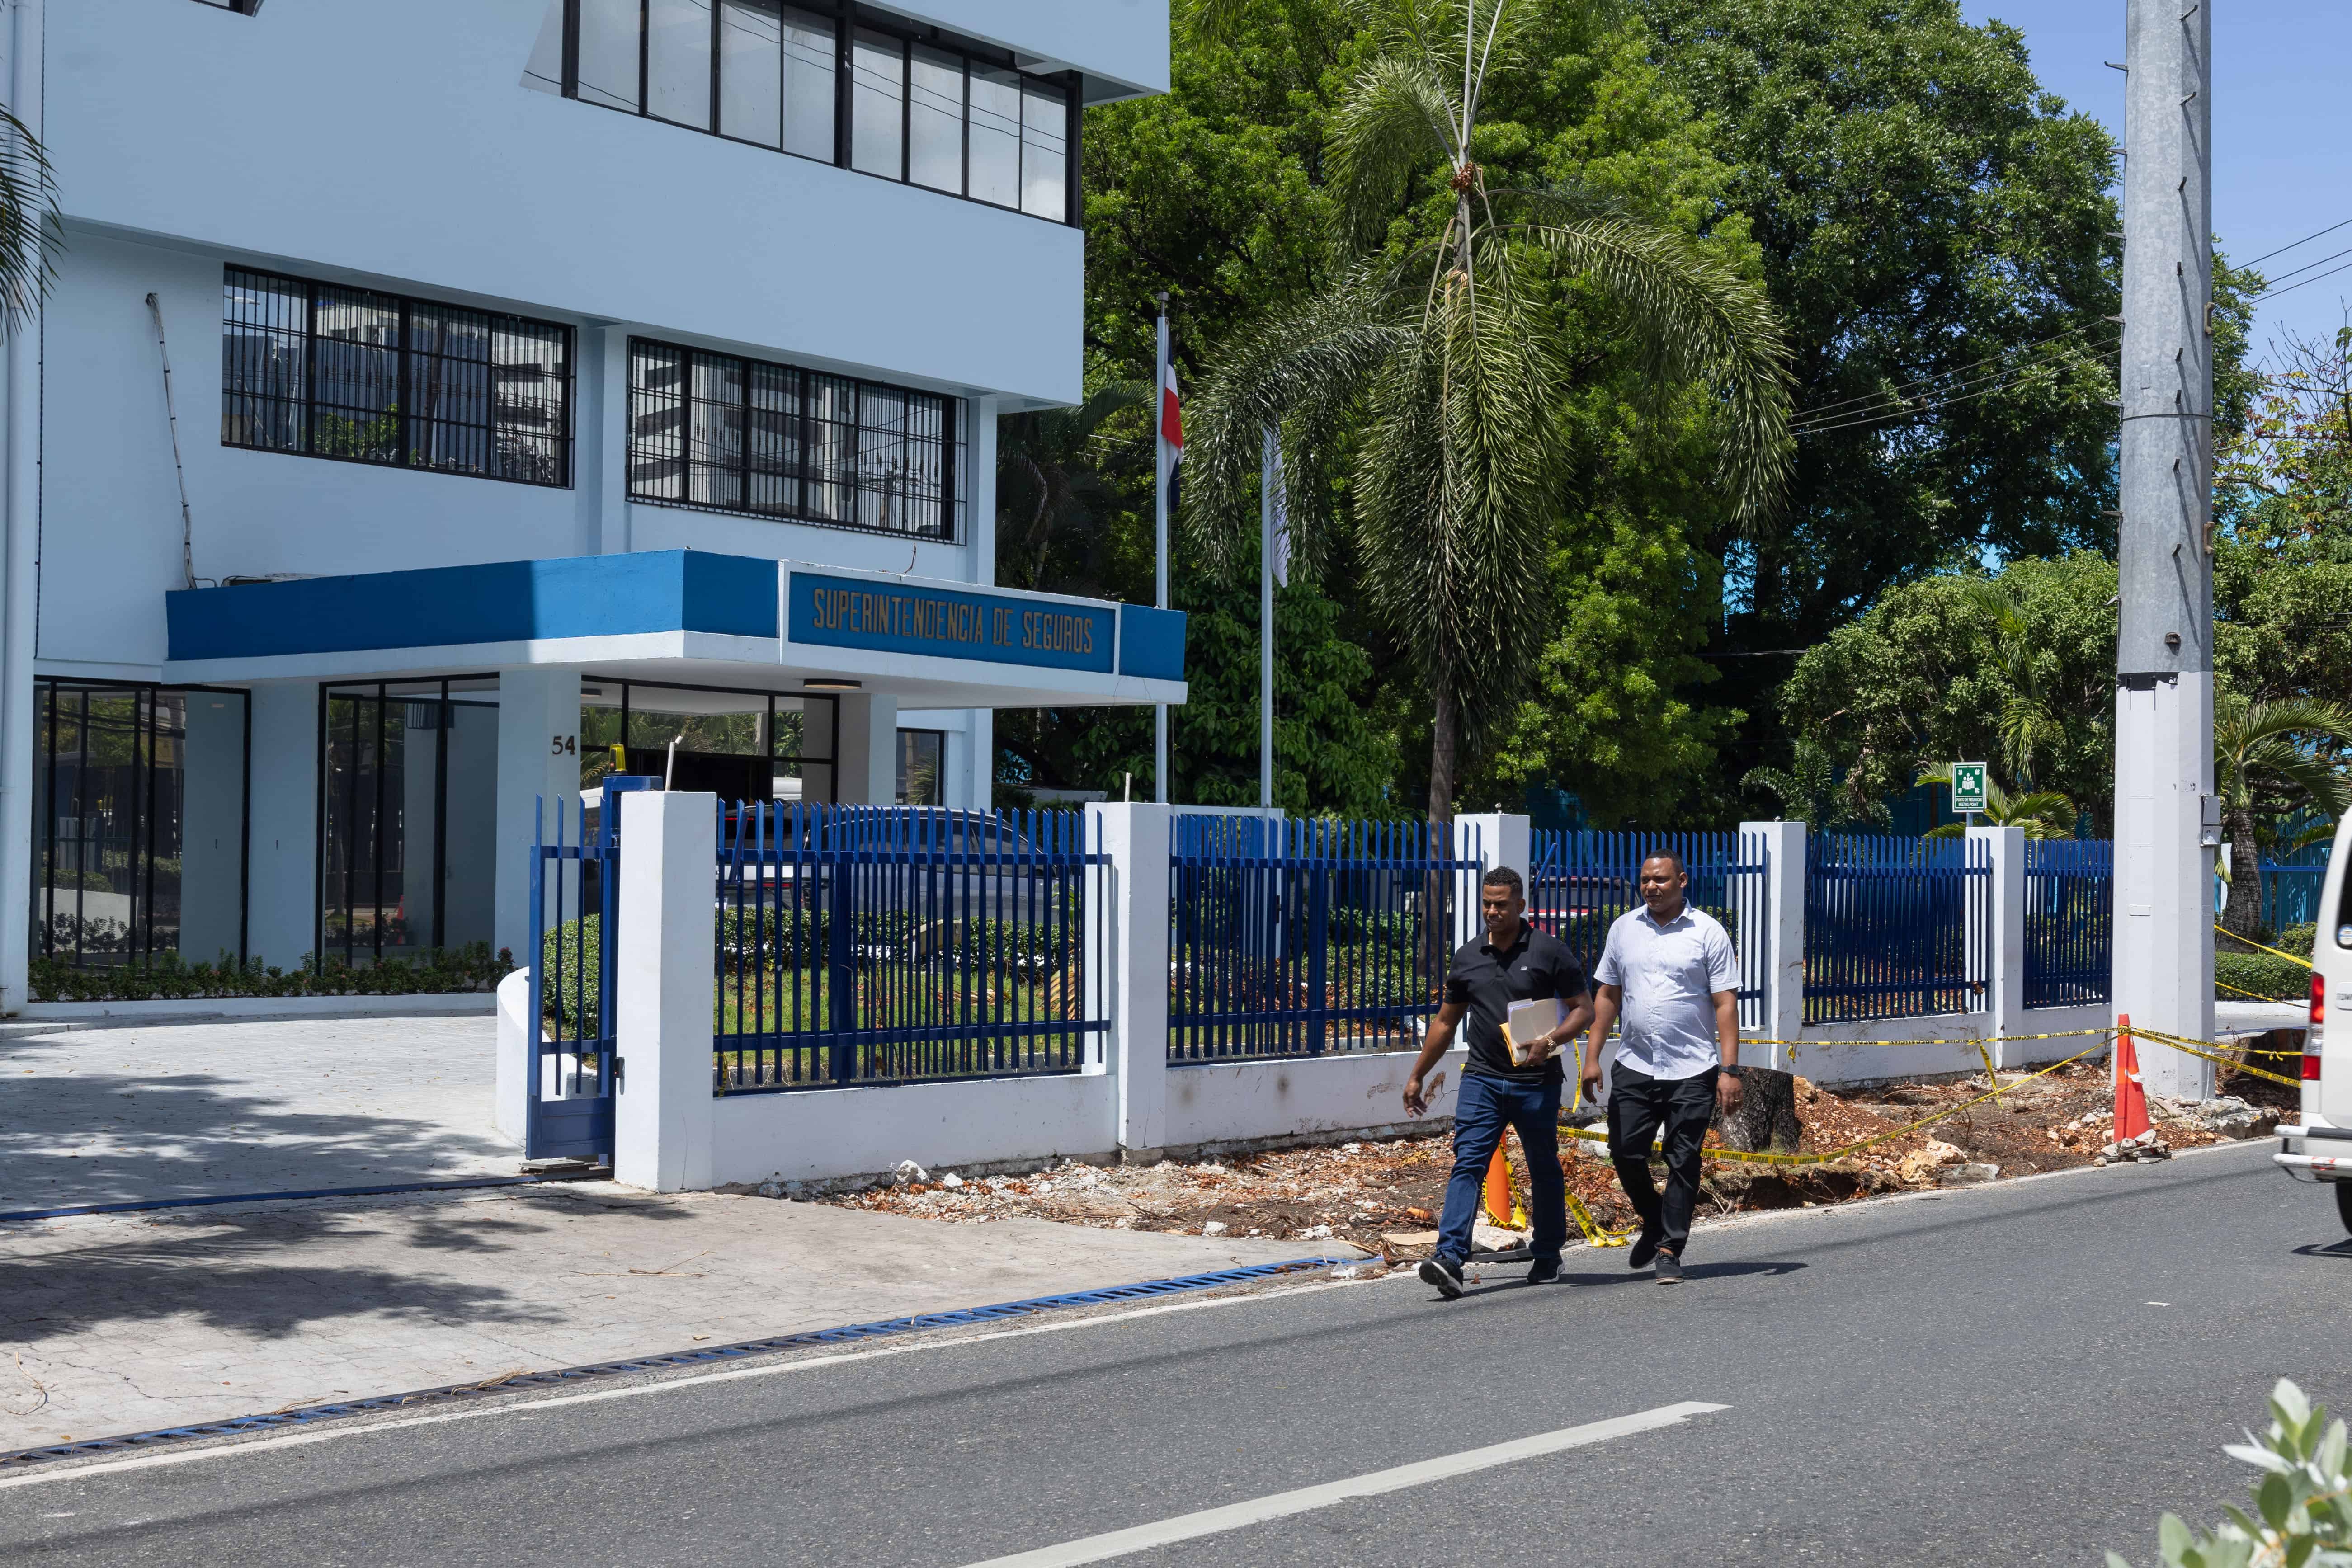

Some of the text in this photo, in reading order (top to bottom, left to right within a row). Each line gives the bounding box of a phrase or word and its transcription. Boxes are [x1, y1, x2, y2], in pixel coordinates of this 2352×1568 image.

[814, 588, 1092, 654] SUPERINTENDENCIA DE SEGUROS
[552, 735, 575, 755] 54
